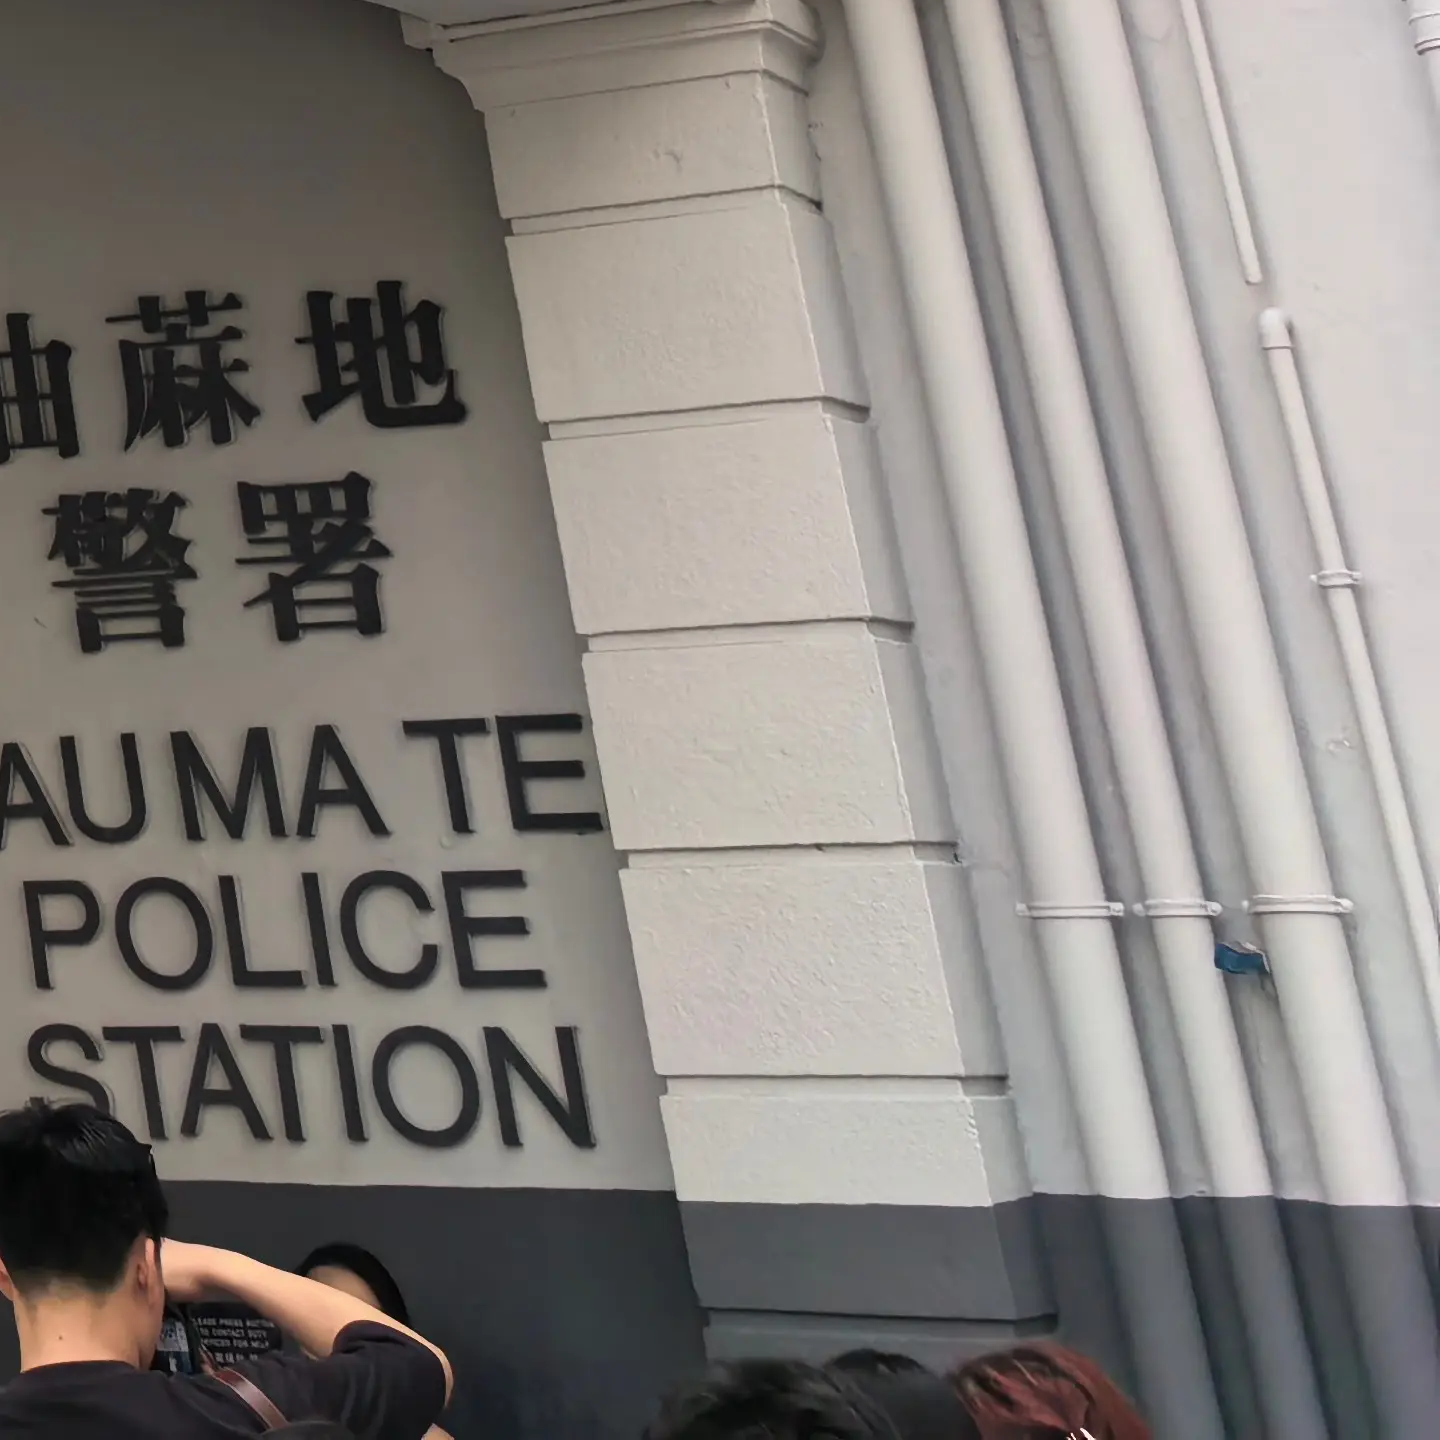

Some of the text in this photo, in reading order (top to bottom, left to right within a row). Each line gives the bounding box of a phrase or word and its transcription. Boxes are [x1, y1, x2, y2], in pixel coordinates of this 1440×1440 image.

[41, 471, 392, 654] 警署
[169, 725, 391, 842] MA
[402, 714, 604, 836] TE
[22, 870, 547, 991] POLICE
[27, 1023, 597, 1149] STATION
